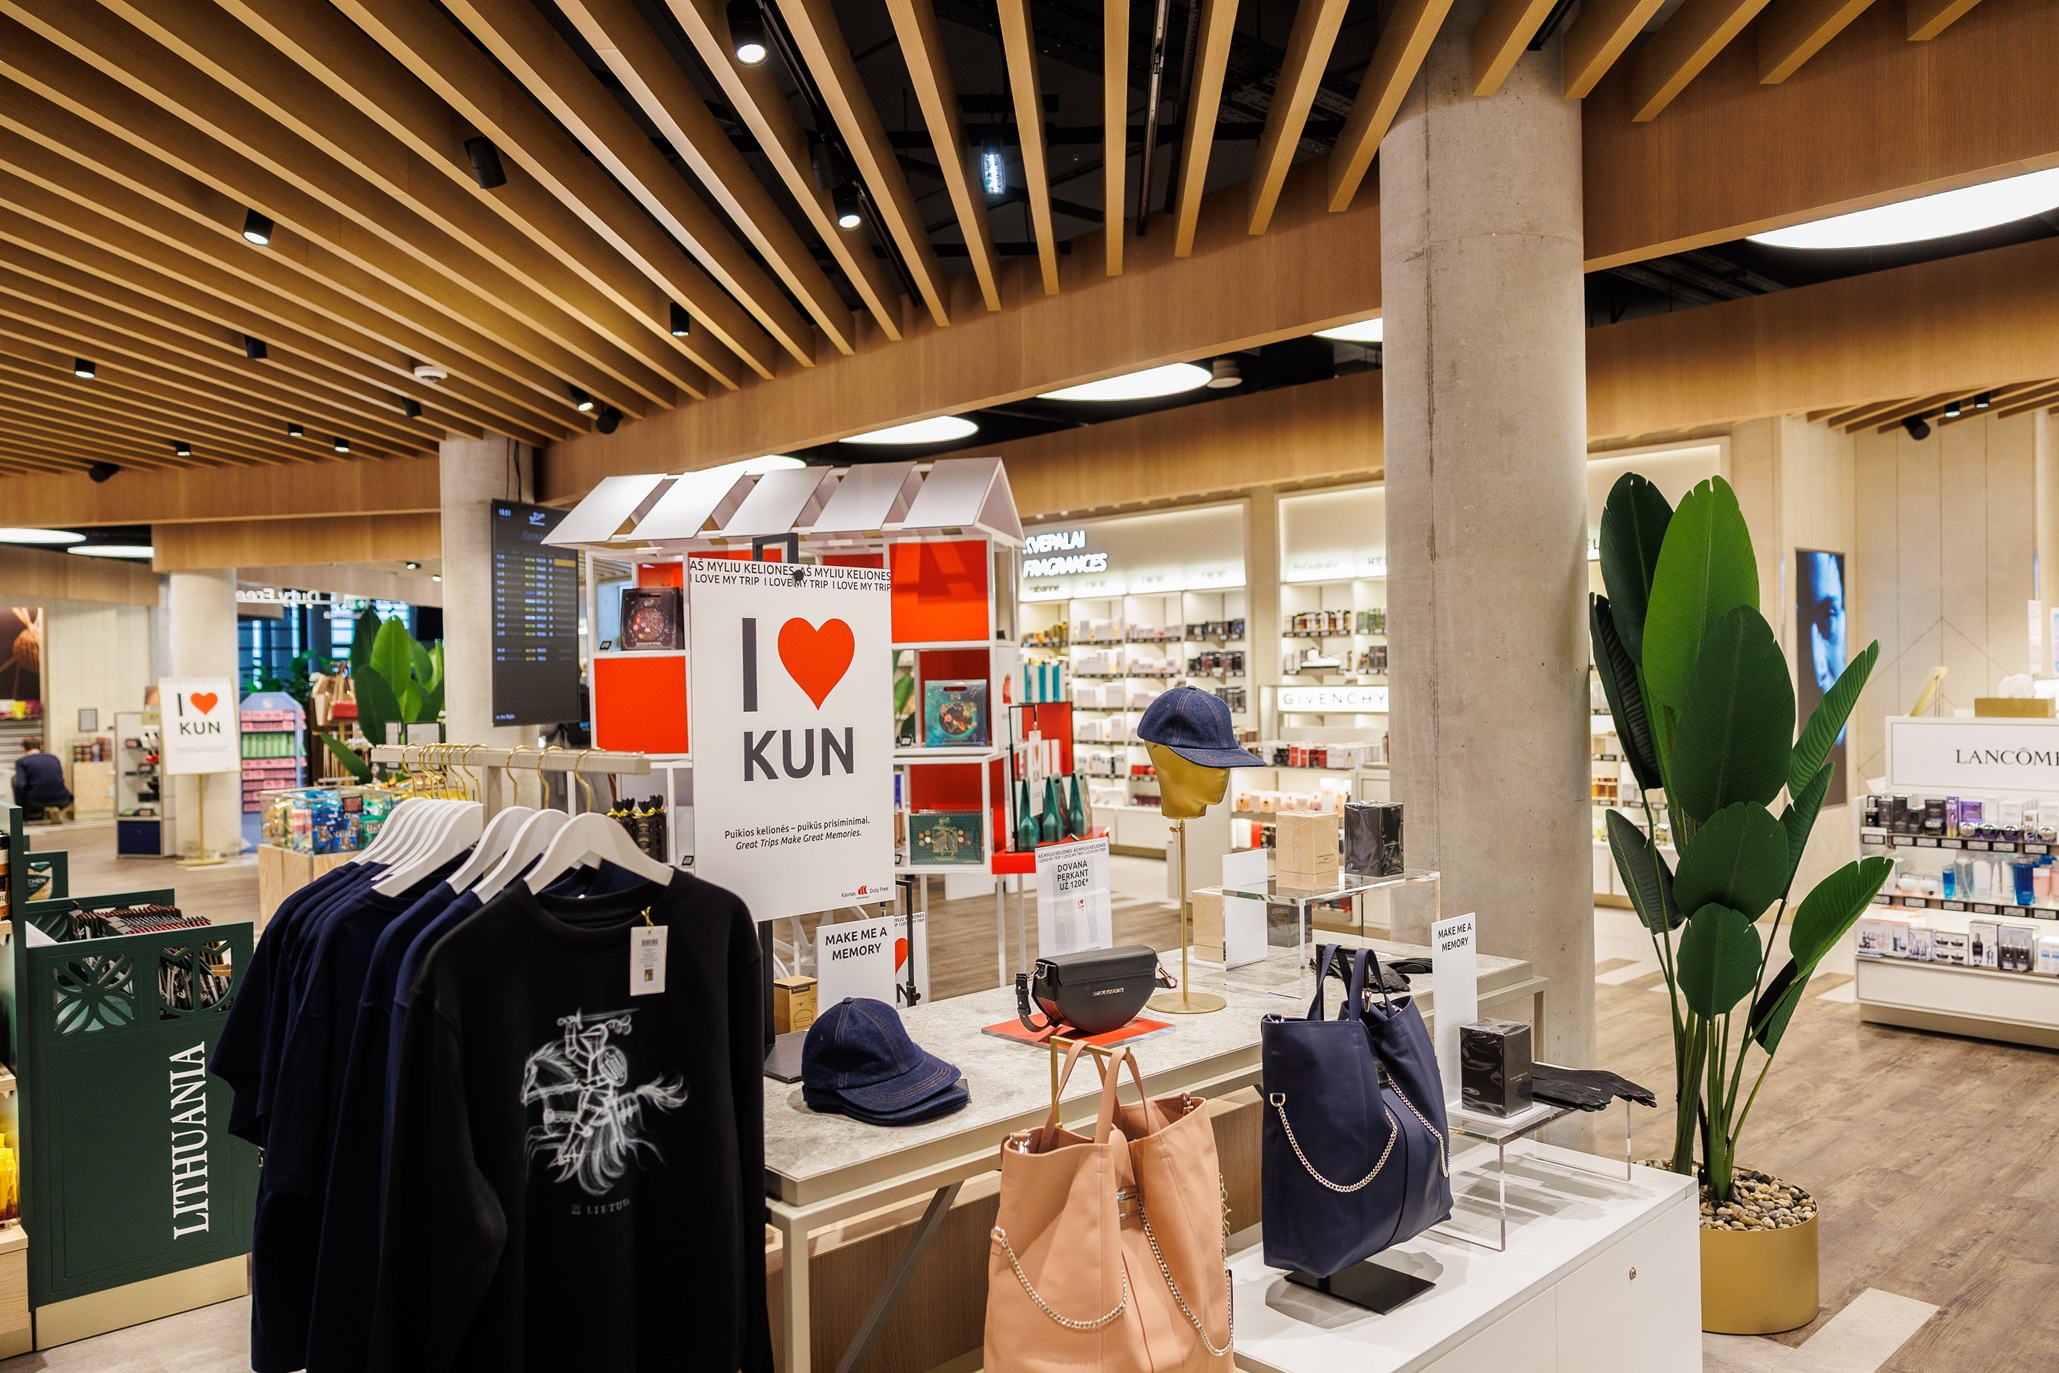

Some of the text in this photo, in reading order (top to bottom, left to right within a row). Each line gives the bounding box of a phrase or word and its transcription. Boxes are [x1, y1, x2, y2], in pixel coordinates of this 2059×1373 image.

[690, 558, 704, 571] AŠ
[707, 561, 741, 573] MYLIU
[744, 563, 795, 576] KELIONES
[815, 567, 844, 579] MYLIU
[847, 569, 891, 581] KELIONES
[1023, 552, 1108, 578] FRAGRANCES
[695, 574, 720, 584] LOVE
[722, 575, 737, 585] MY
[739, 576, 760, 586] TRIP
[764, 577, 767, 586] I
[769, 577, 793, 587] LOVE
[809, 579, 829, 589] TRIP
[832, 580, 835, 589] I
[837, 581, 858, 590] LOVE
[860, 582, 873, 591] MY
[874, 583, 891, 592] TRIP
[742, 617, 758, 712] I
[177, 693, 183, 717] I
[1283, 693, 1386, 705] GIVENCHY
[179, 721, 221, 735] KUN
[743, 727, 854, 782] KUN
[725, 828, 755, 839] Puikios
[756, 824, 790, 836] kelionės
[797, 821, 822, 832] puikūs
[823, 816, 870, 830] prisiminimai.
[735, 828, 862, 850] Great Trips Make Great Memories.
[1057, 860, 1088, 873] DOVANA
[1057, 869, 1089, 882] PERKANT
[1059, 880, 1069, 891] UŽ
[825, 927, 888, 946] MAKE ME A
[1438, 922, 1472, 939] MAKE ME A
[832, 943, 882, 961] MEMORY
[1441, 936, 1469, 952] MEMORY
[168, 1041, 209, 1240] LITHUANIA
